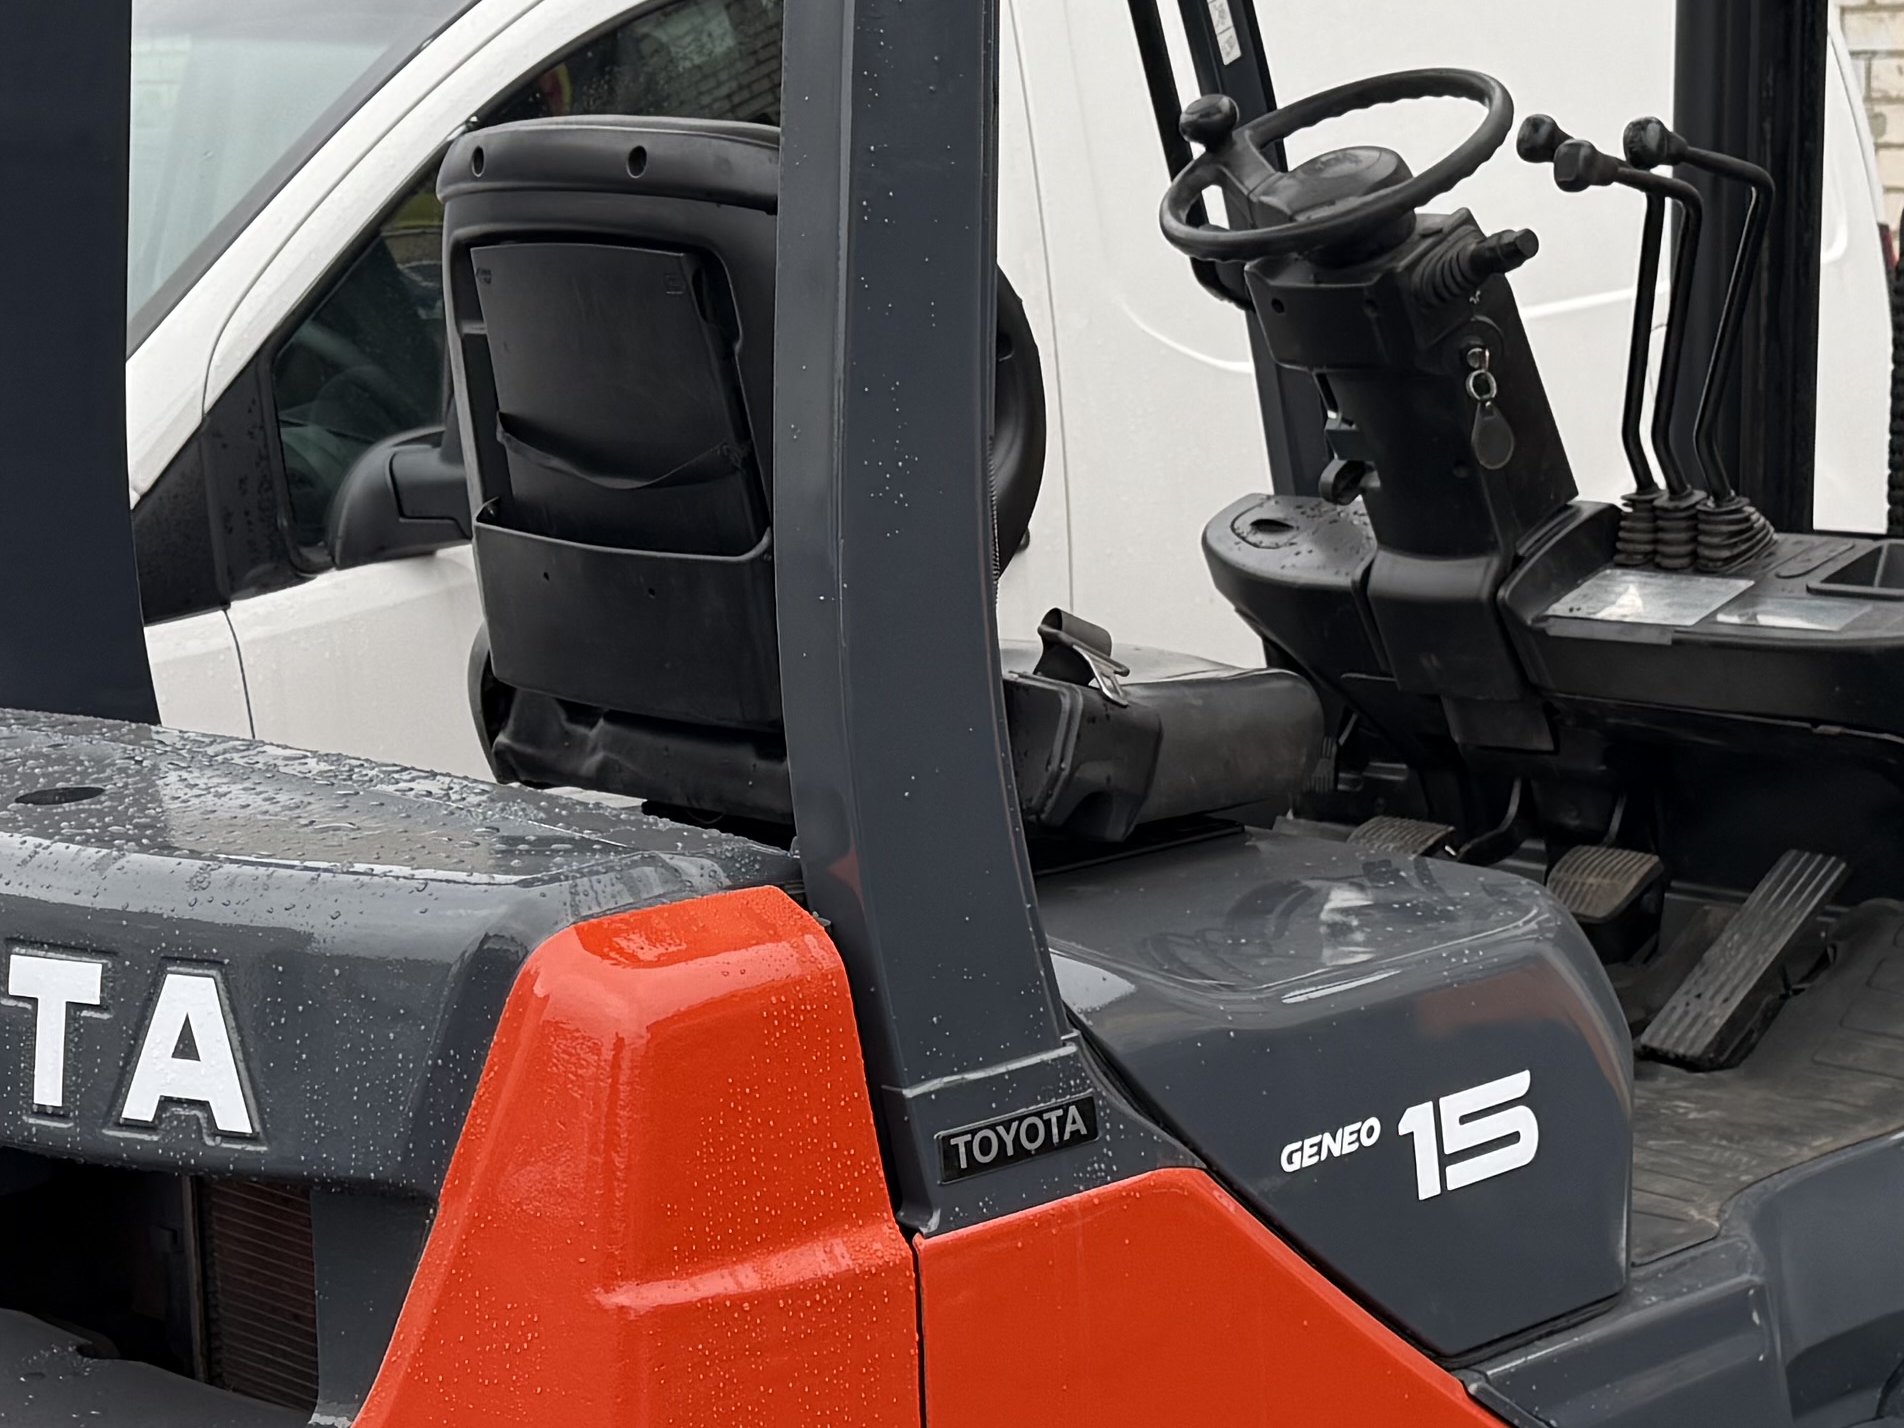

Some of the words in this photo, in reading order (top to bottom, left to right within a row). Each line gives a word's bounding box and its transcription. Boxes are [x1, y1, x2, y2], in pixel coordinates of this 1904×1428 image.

[950, 1104, 1088, 1171] TOYOTA
[1279, 1116, 1382, 1174] GENEO
[1398, 1069, 1540, 1201] 15
